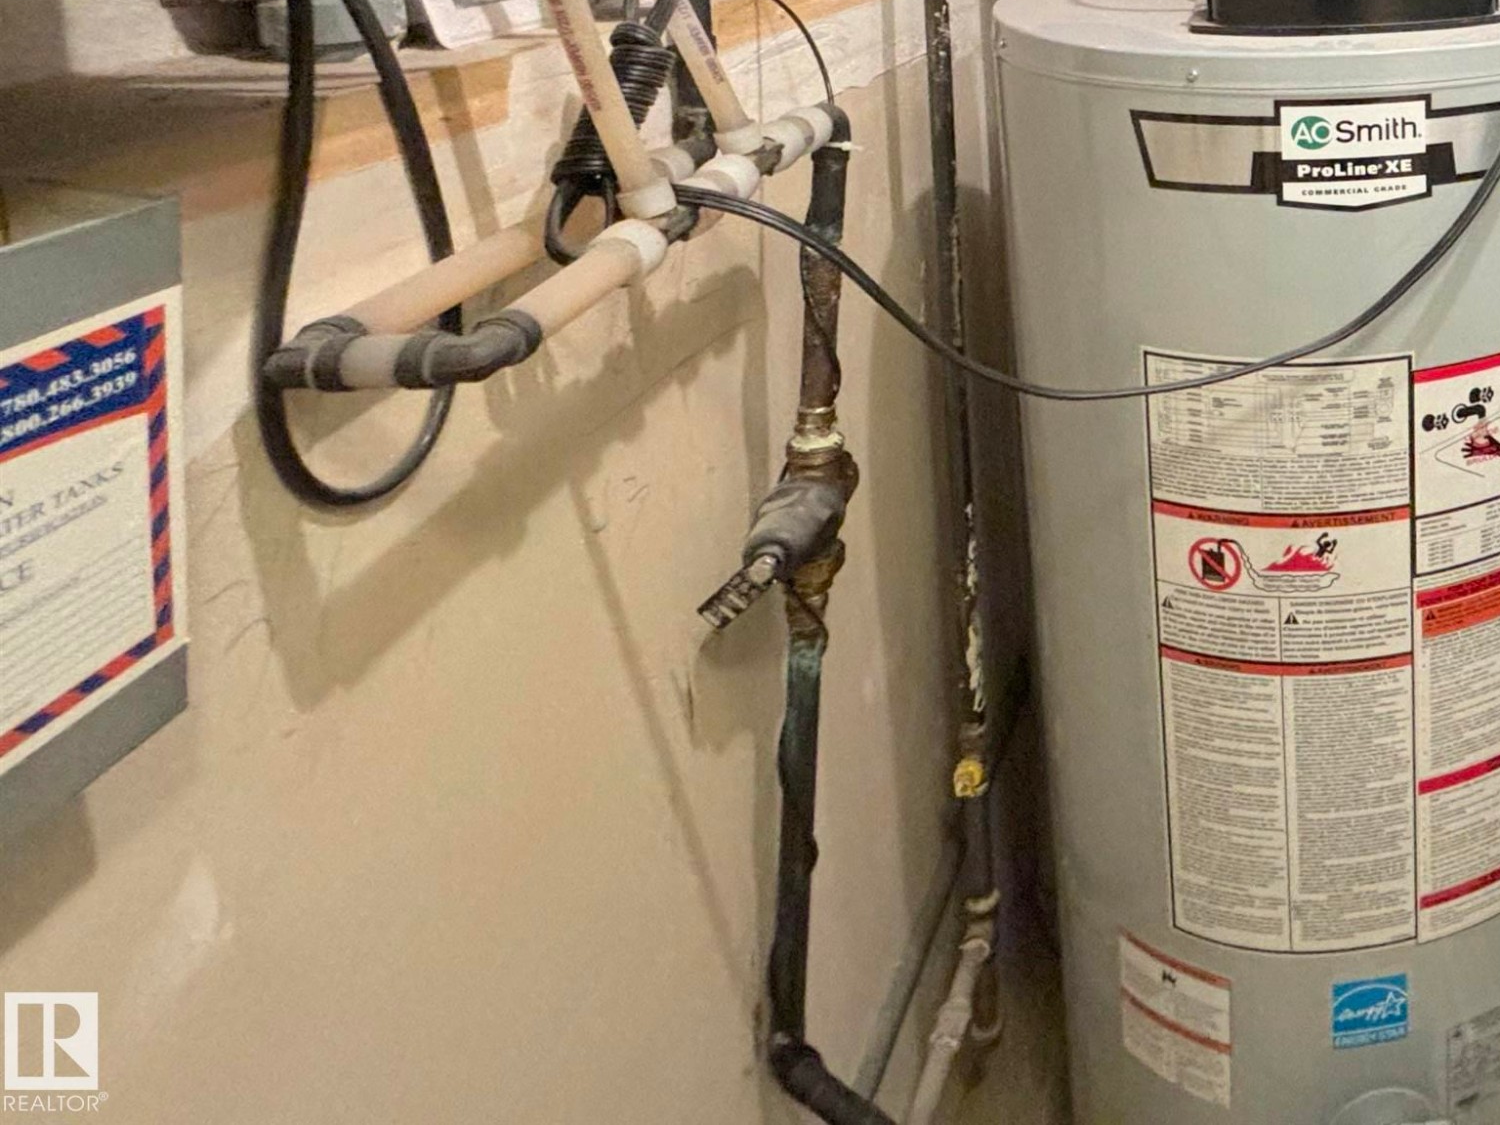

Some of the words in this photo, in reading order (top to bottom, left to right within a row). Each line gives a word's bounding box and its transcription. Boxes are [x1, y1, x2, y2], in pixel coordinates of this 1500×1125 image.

[1336, 117, 1417, 143] Smith
[1297, 162, 1379, 177] ProLine
[1385, 159, 1412, 174] XE
[1301, 187, 1369, 196] COMMERCIAL
[1374, 184, 1407, 194] GRADE
[1302, 511, 1396, 528] AVERTISSEMENT
